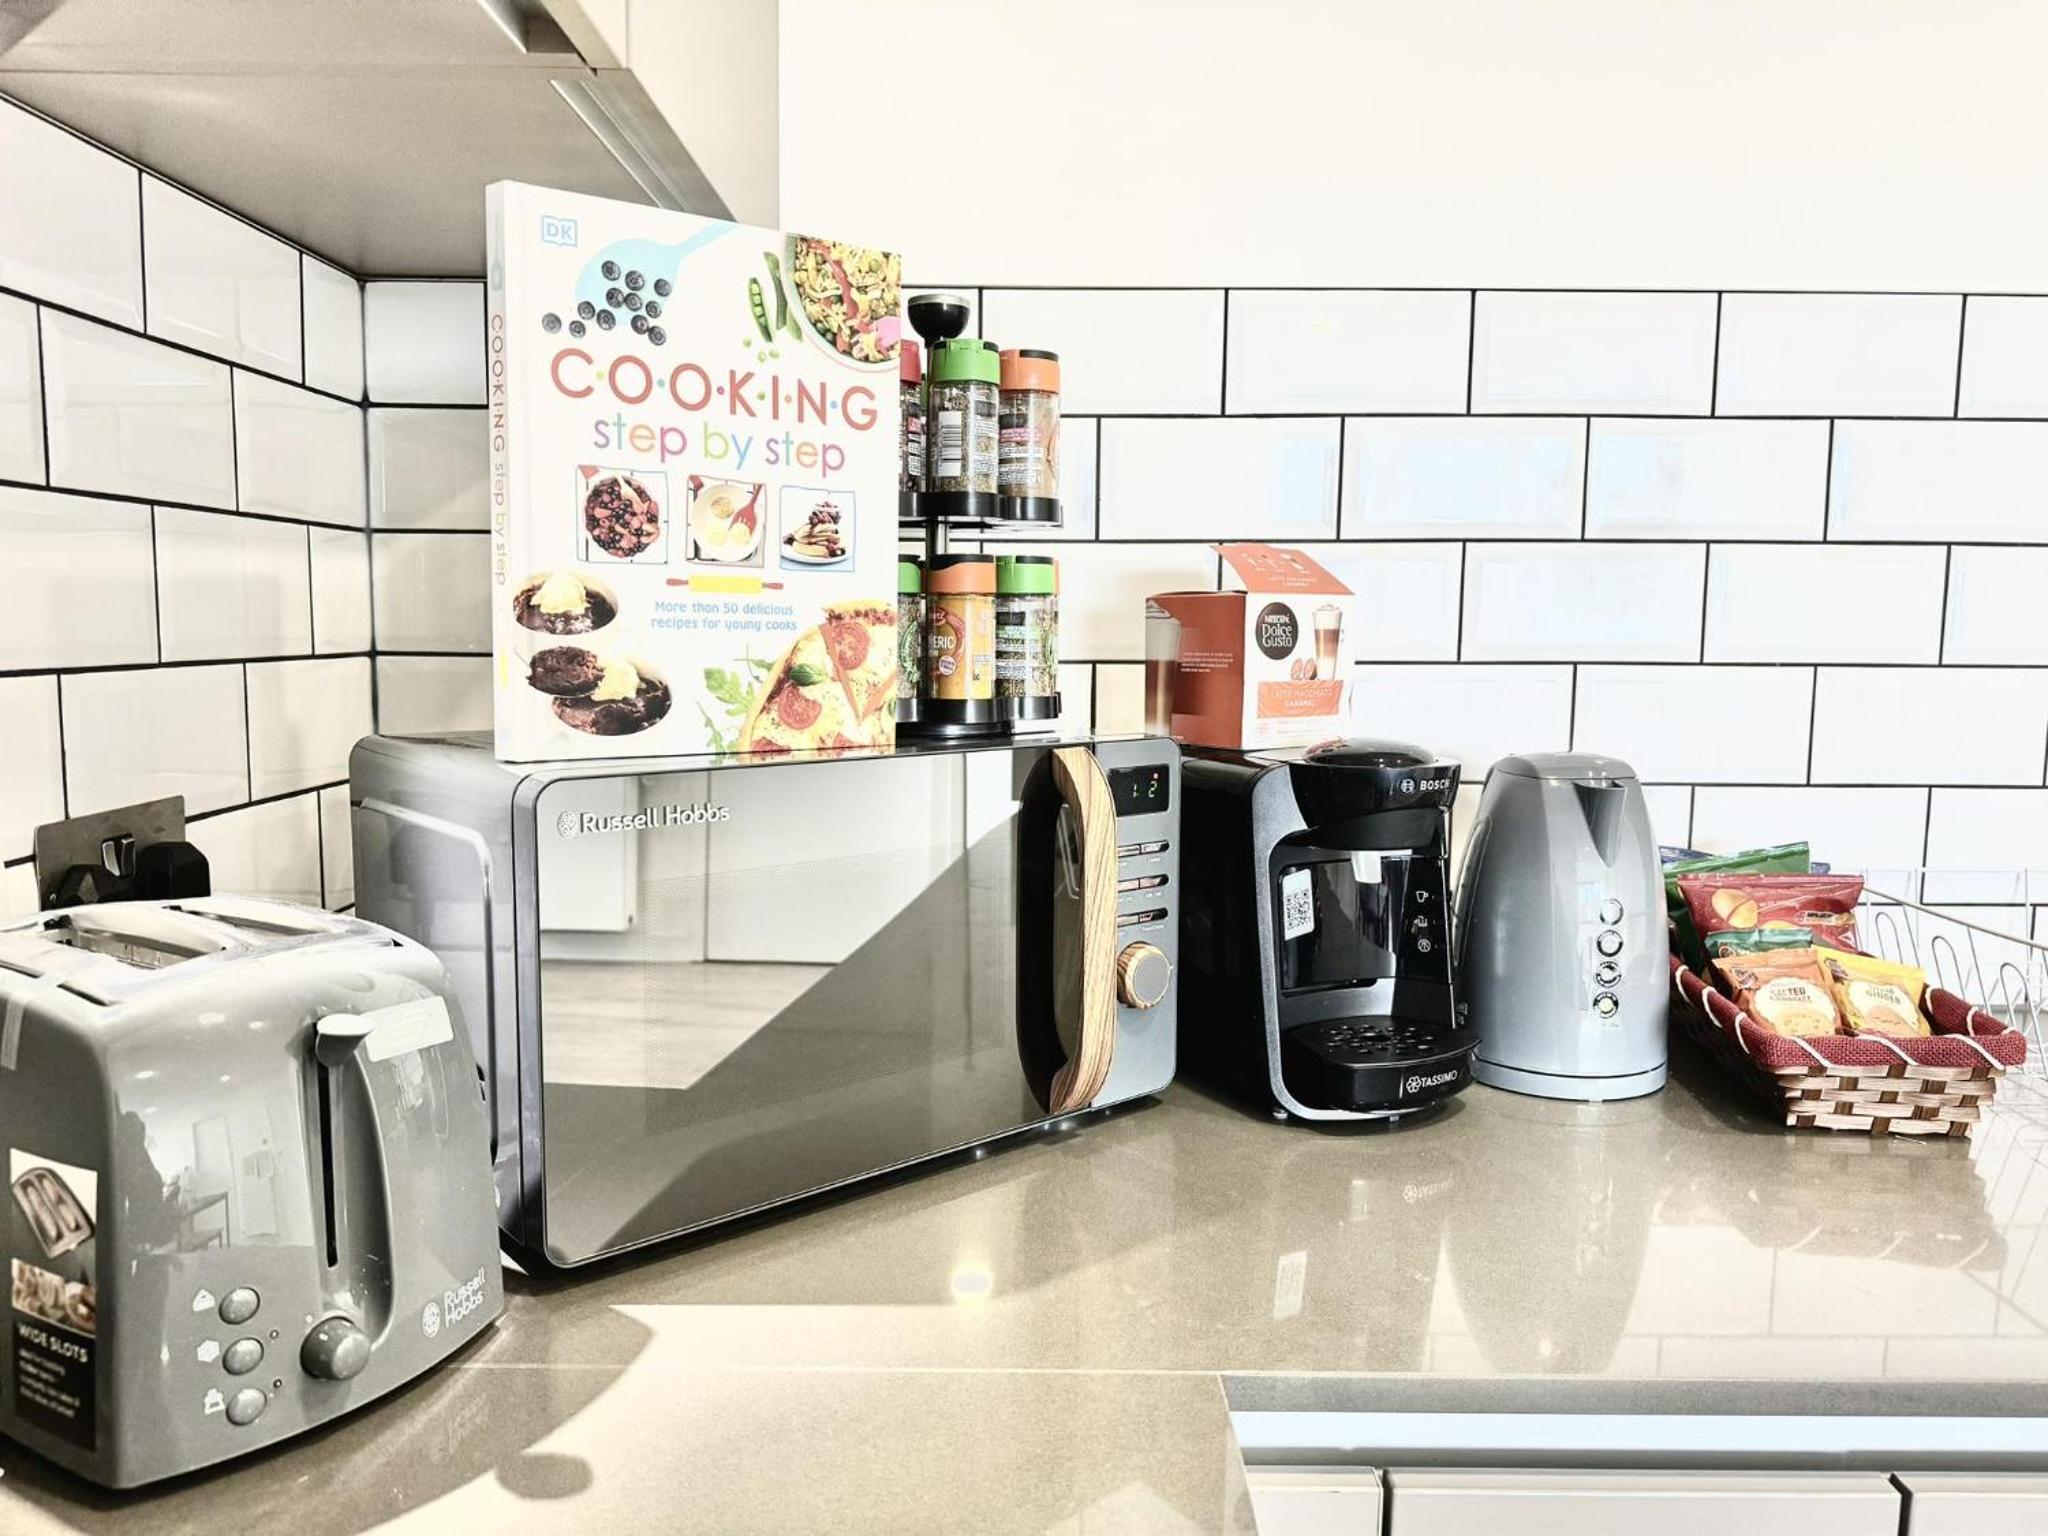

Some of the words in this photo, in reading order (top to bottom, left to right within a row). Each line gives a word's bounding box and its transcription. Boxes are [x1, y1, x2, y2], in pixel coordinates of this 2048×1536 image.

[547, 222, 573, 241] DK
[593, 412, 688, 463] step
[703, 421, 754, 470] by
[765, 430, 846, 478] step
[654, 601, 687, 613] More
[692, 602, 719, 614] than
[723, 603, 738, 615] 50
[742, 603, 794, 616] delicious
[650, 616, 698, 630] recipes
[702, 617, 720, 630] for
[724, 620, 761, 632] young
[765, 619, 797, 631] cooks
[1262, 623, 1293, 637] Dolce
[1262, 635, 1293, 648] Gusto
[1420, 778, 1450, 791] BOSCH
[579, 808, 659, 834] Russell
[662, 802, 730, 827] Hobbs
[1421, 1070, 1457, 1088] TASSIMO
[444, 1266, 485, 1308] Russell
[445, 1291, 483, 1328] Hobbs
[18, 1323, 48, 1347] WIDE
[49, 1336, 88, 1363] SLOTS
